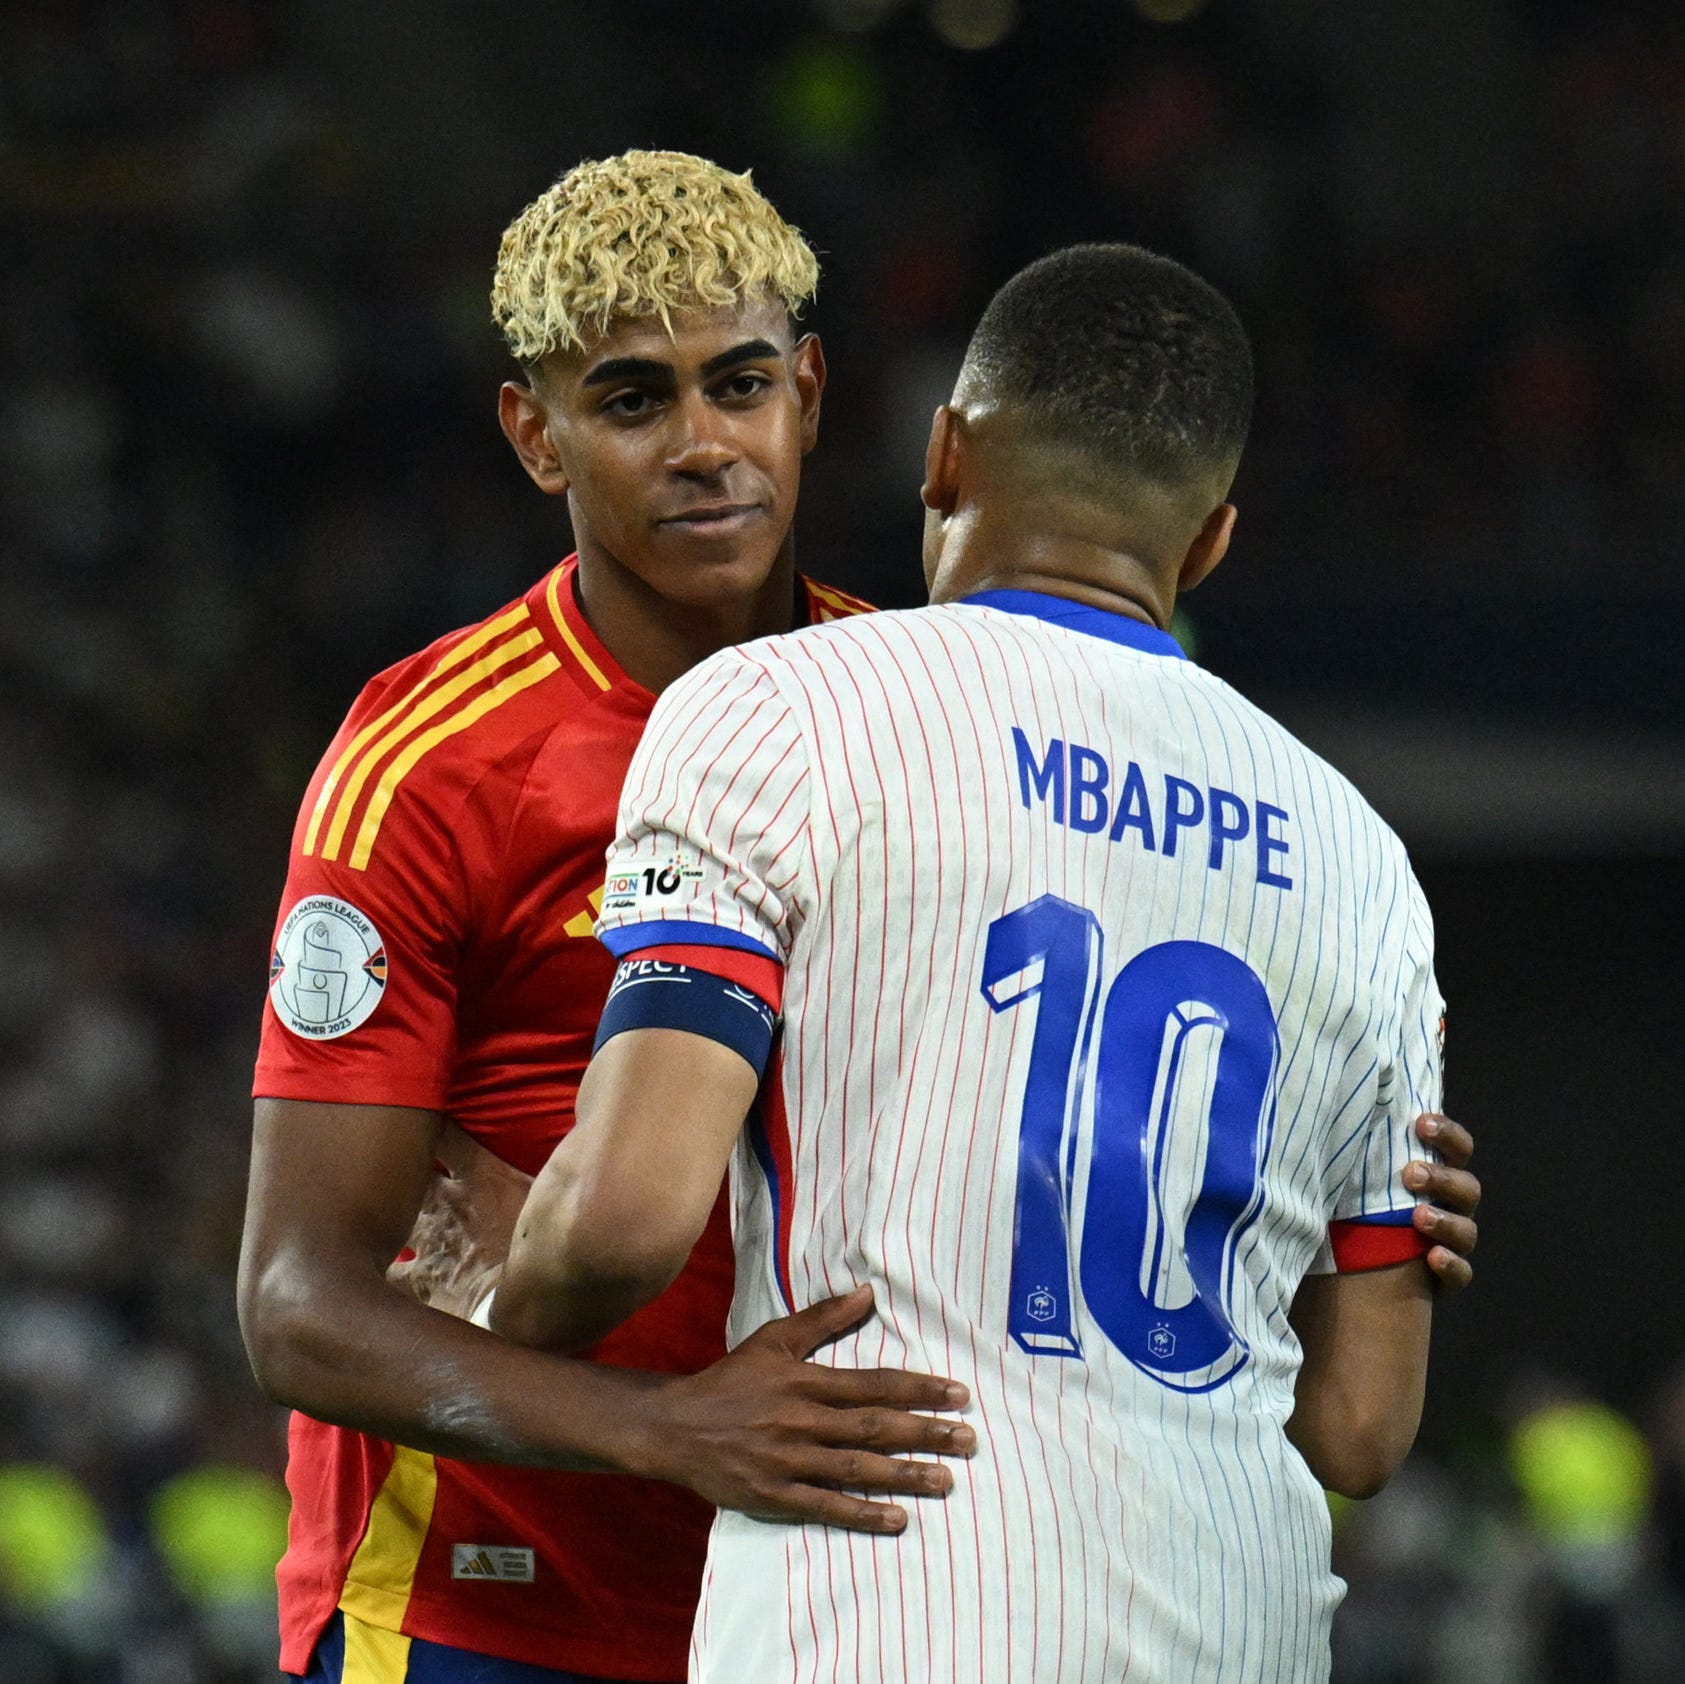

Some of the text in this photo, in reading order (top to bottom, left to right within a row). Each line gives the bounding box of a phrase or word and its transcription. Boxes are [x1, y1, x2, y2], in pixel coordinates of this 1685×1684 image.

[1012, 726, 1293, 890] MBAPPE
[642, 867, 681, 896] 10
[299, 900, 333, 915] NATIONS
[334, 904, 370, 935] LEAGUE
[610, 959, 687, 988] SPEC
[291, 1017, 351, 1035] WINNER 2023
[981, 893, 1281, 1394] 10
